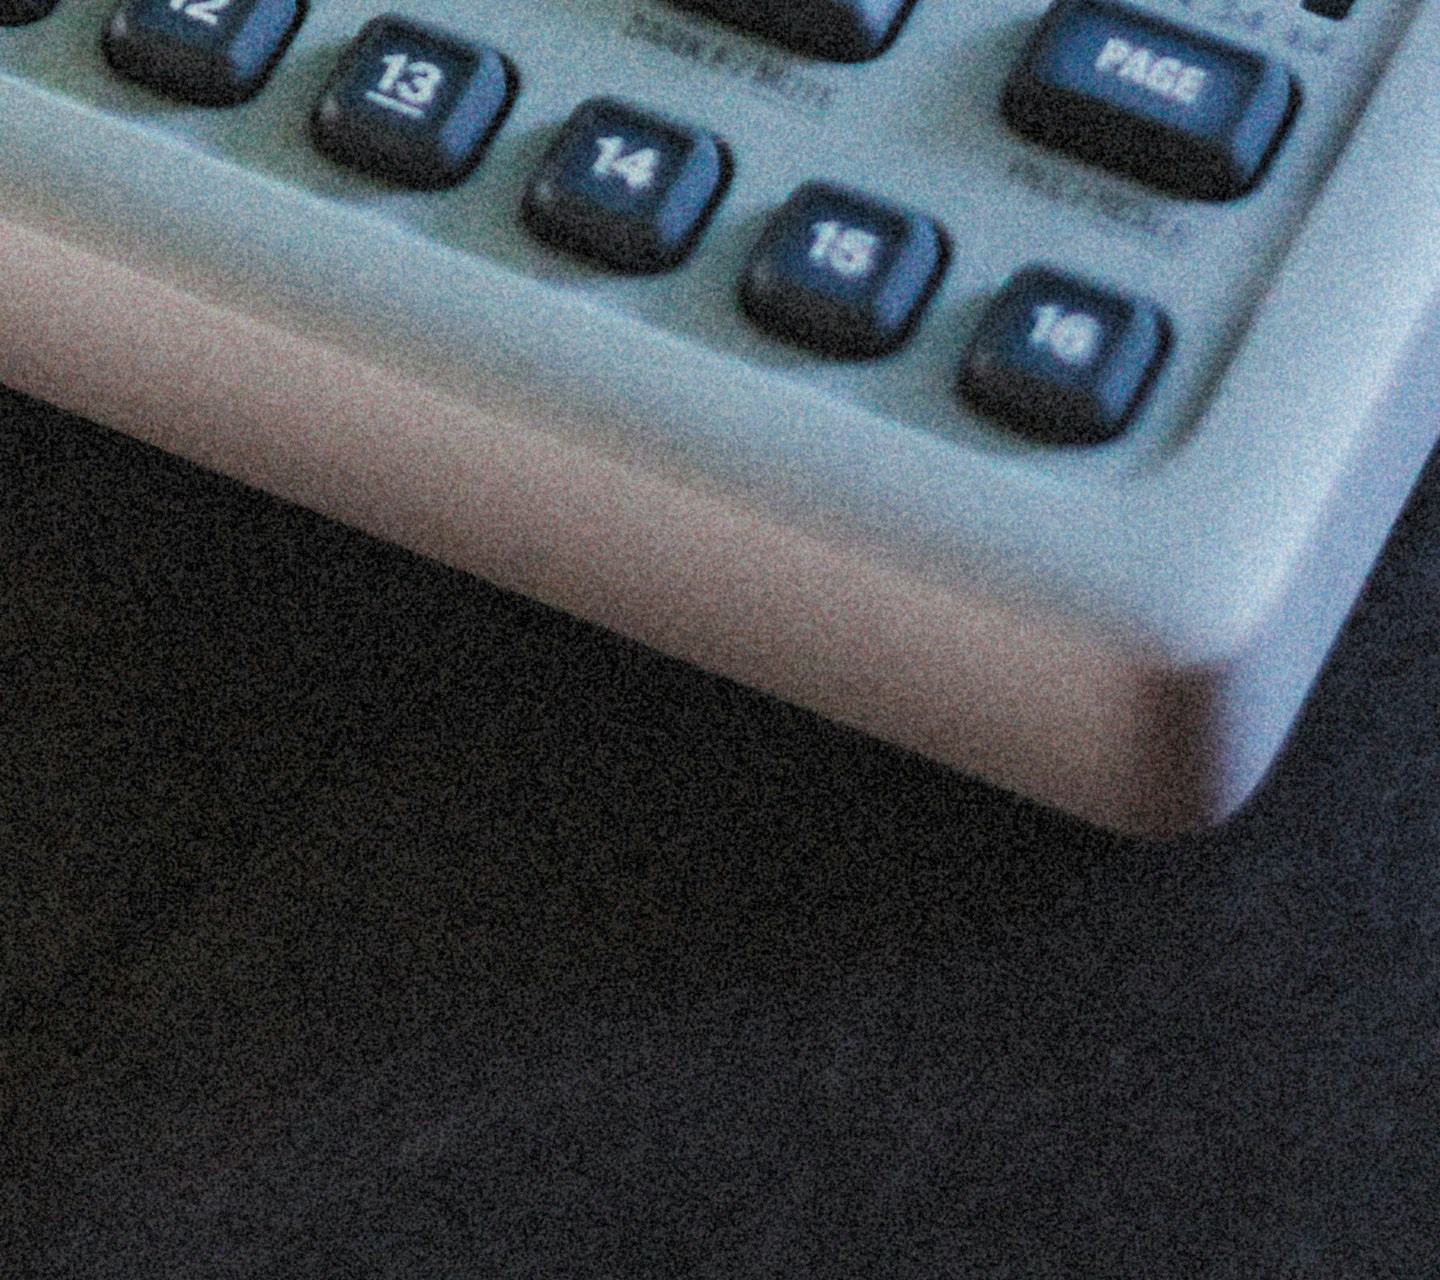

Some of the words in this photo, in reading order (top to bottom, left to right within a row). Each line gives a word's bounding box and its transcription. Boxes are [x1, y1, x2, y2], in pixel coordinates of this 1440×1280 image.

[376, 53, 443, 105] 13
[1095, 37, 1207, 104] PAGE
[591, 137, 658, 188] 14
[810, 222, 880, 277] 15
[1030, 304, 1102, 364] 16
